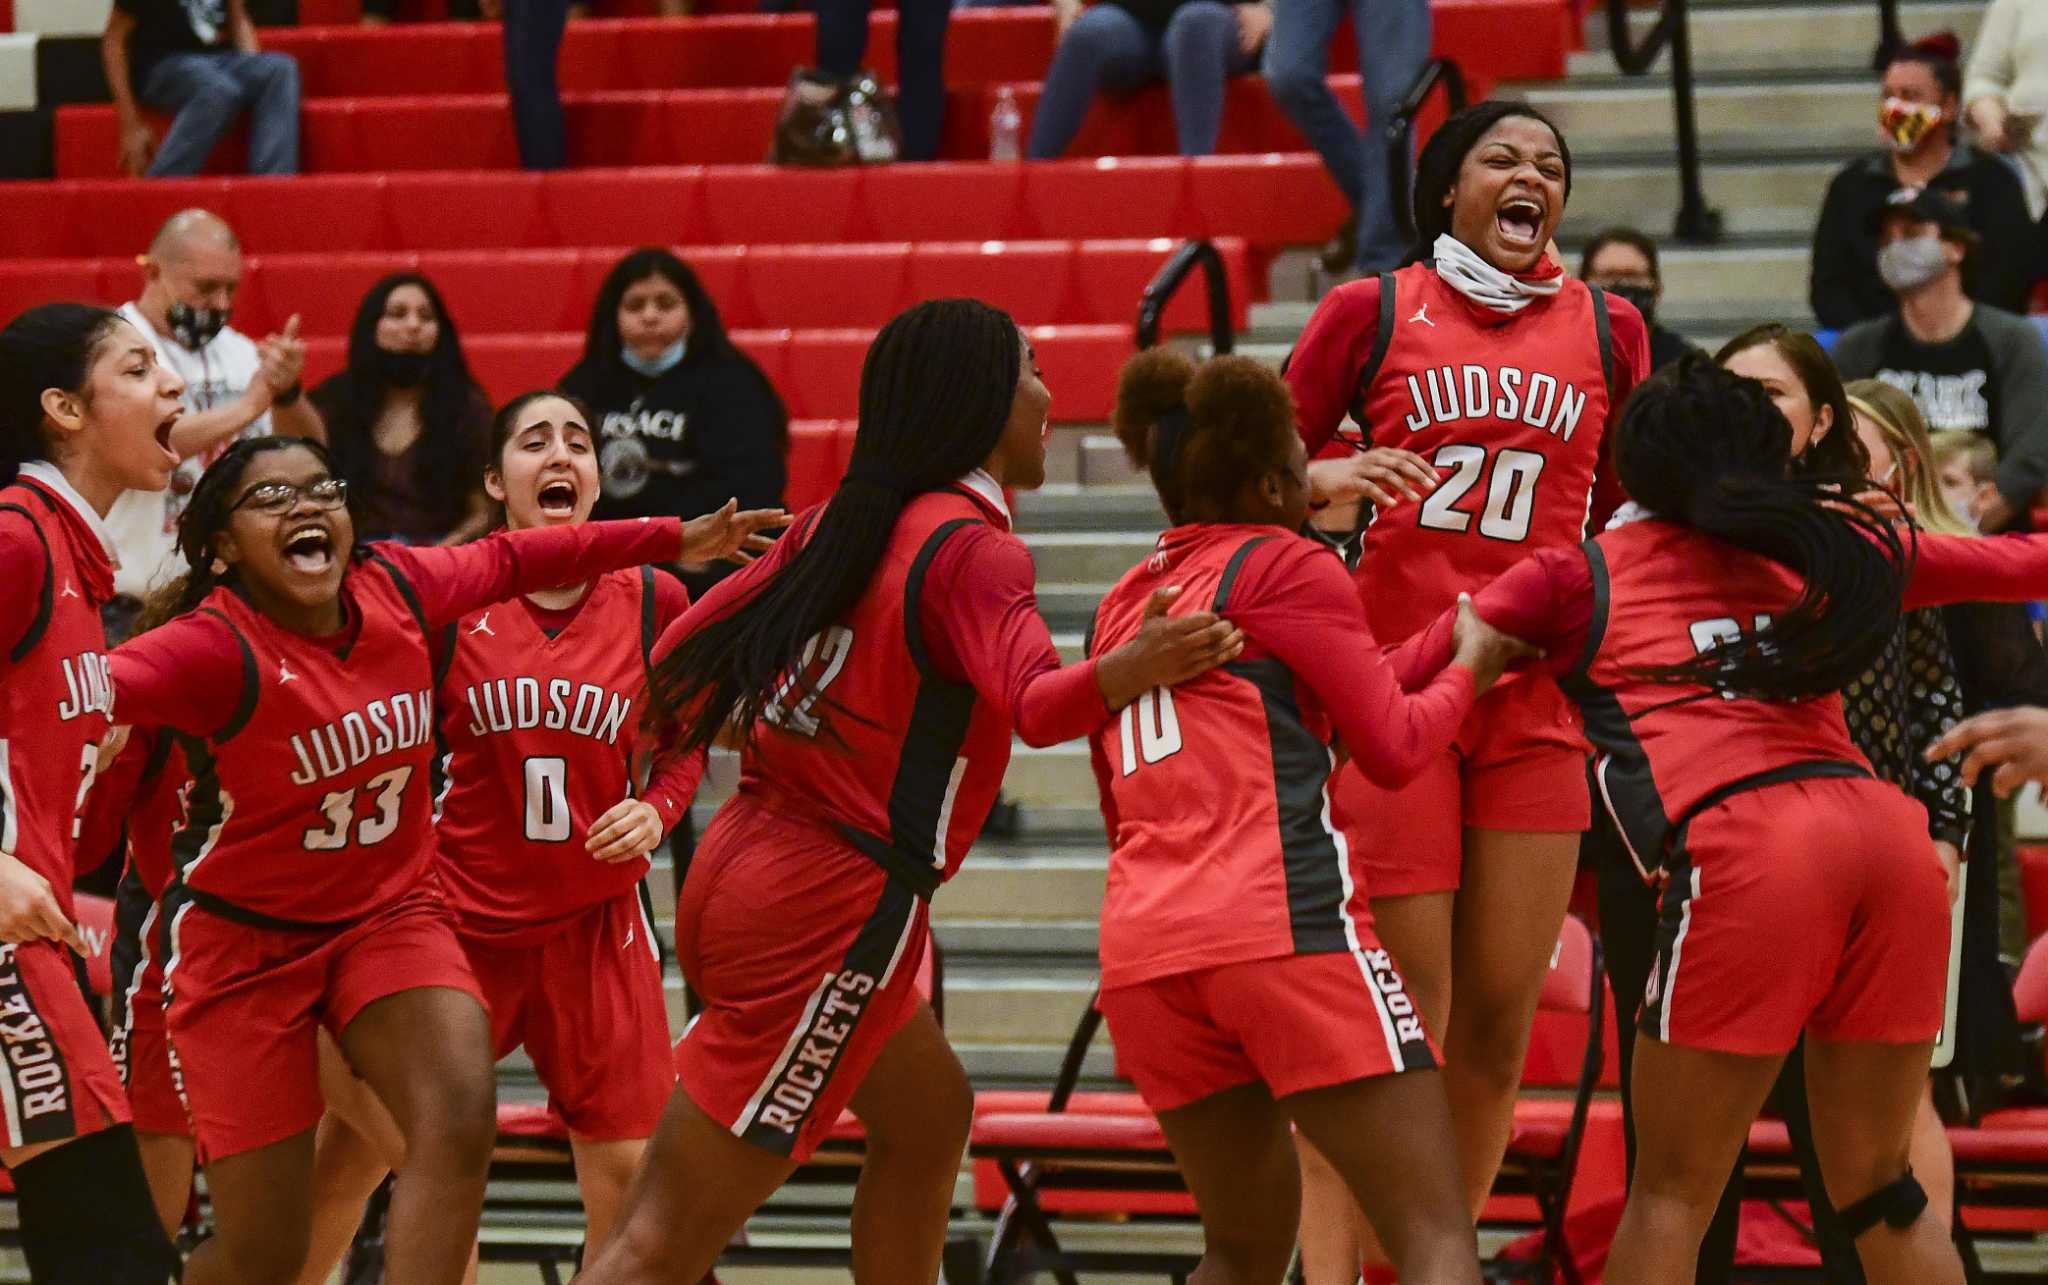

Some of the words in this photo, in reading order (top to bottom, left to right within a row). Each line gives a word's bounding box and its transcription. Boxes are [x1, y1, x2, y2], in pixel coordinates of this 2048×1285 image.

[1405, 364, 1586, 442] JUDSON
[1419, 443, 1545, 542] 20
[289, 688, 432, 785] JUDSON
[466, 676, 631, 745] JUDSON
[1120, 685, 1183, 777] 10
[303, 765, 413, 849] 33
[523, 755, 571, 841] 0
[759, 970, 875, 1134] ROCKETS
